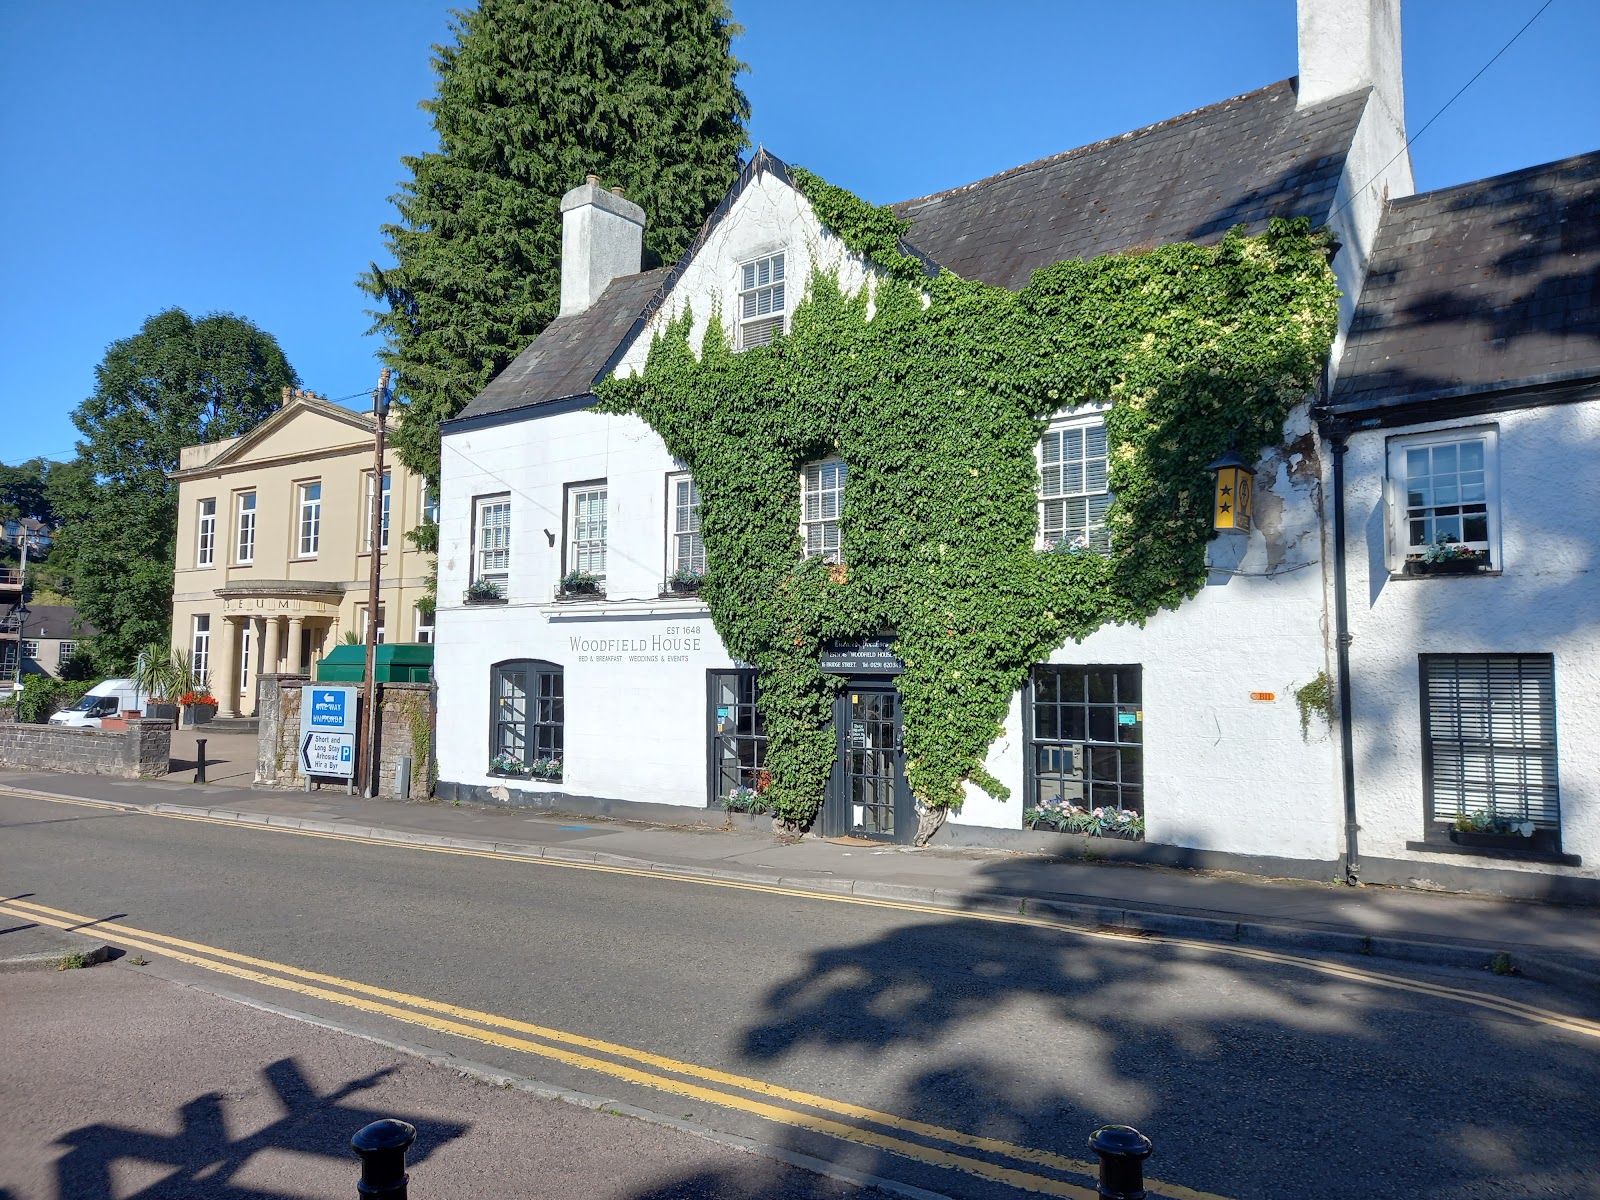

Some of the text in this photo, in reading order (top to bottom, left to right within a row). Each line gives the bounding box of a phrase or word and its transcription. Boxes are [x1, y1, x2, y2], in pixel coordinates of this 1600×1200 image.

[666, 625, 701, 635] EST 1648
[569, 634, 701, 652] WOODFIELD HOUSE
[314, 743, 341, 753] Long Stay
[316, 752, 338, 760] Arhosiad
[342, 748, 350, 760] P
